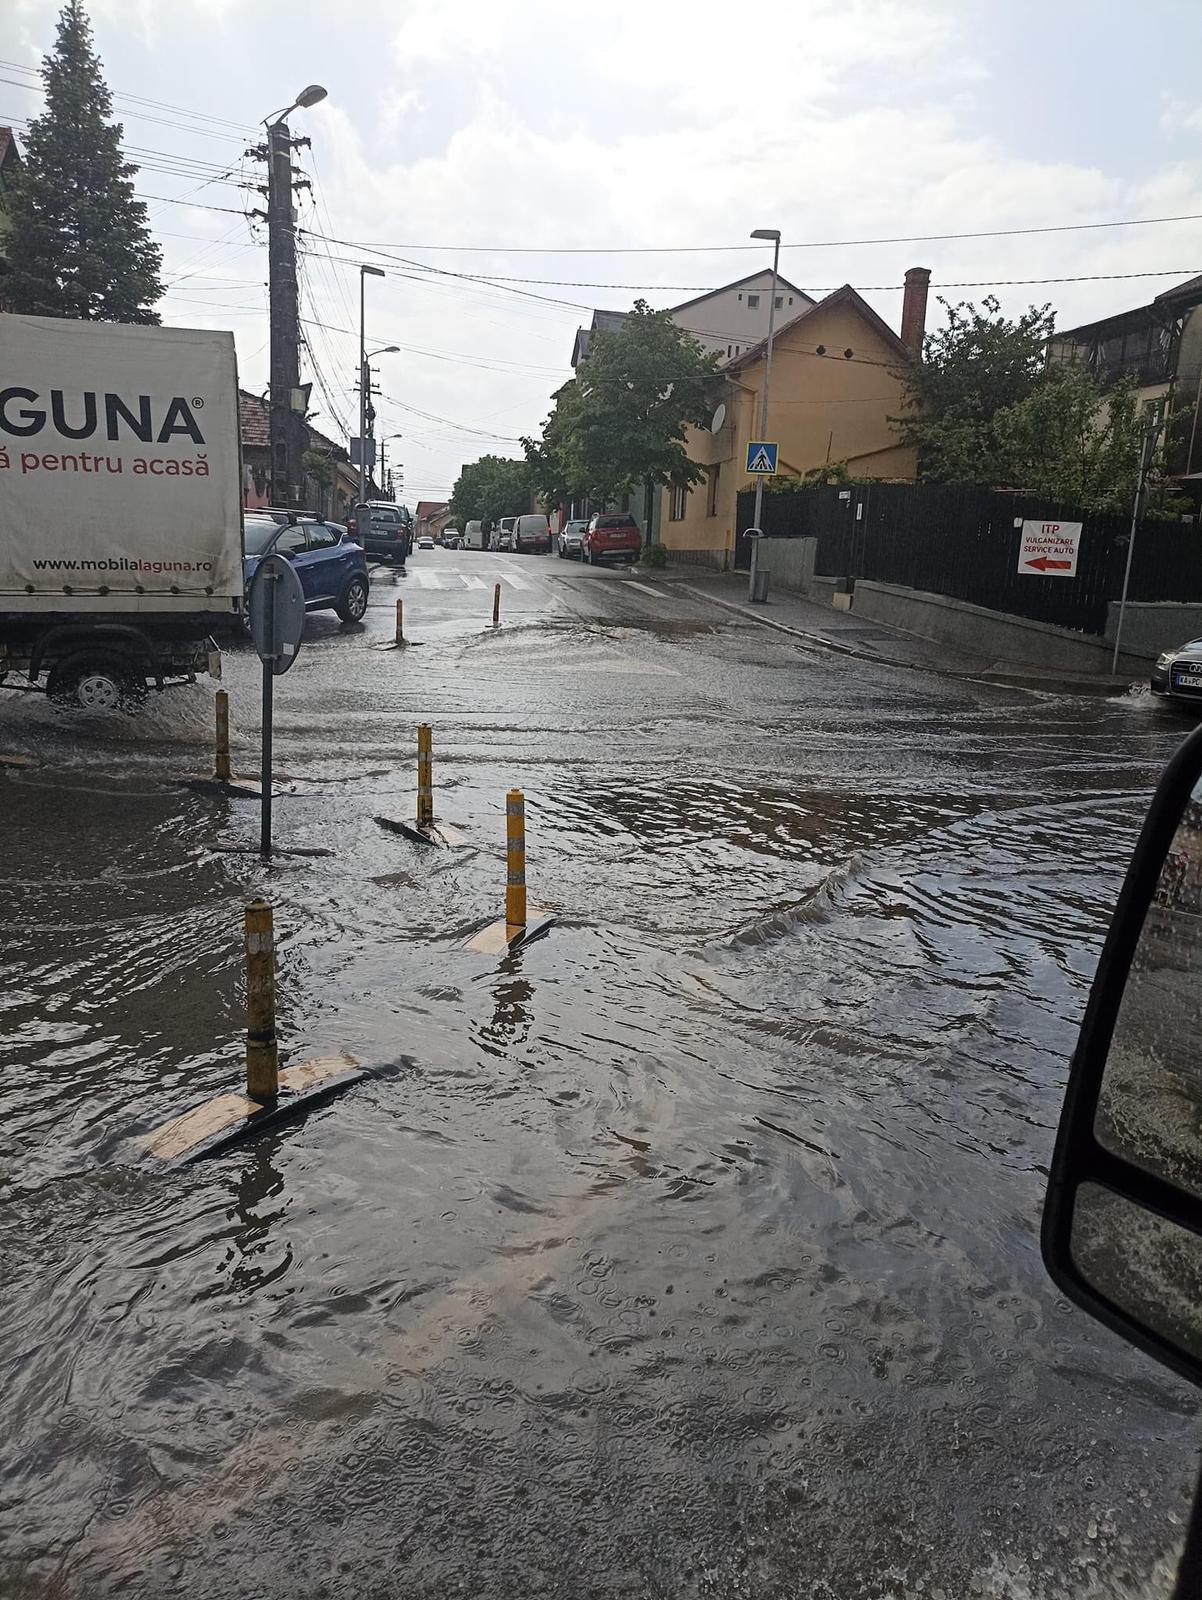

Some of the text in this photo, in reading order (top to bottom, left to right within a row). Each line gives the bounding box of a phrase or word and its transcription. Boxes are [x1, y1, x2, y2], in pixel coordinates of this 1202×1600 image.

[21, 452, 121, 474] pentru
[133, 453, 209, 476] acasă
[1041, 524, 1060, 534] ITP
[1025, 537, 1074, 545] VULCANIZARE
[1024, 545, 1052, 553] SERVICE
[33, 558, 212, 573] www.mobilalaguna.ro
